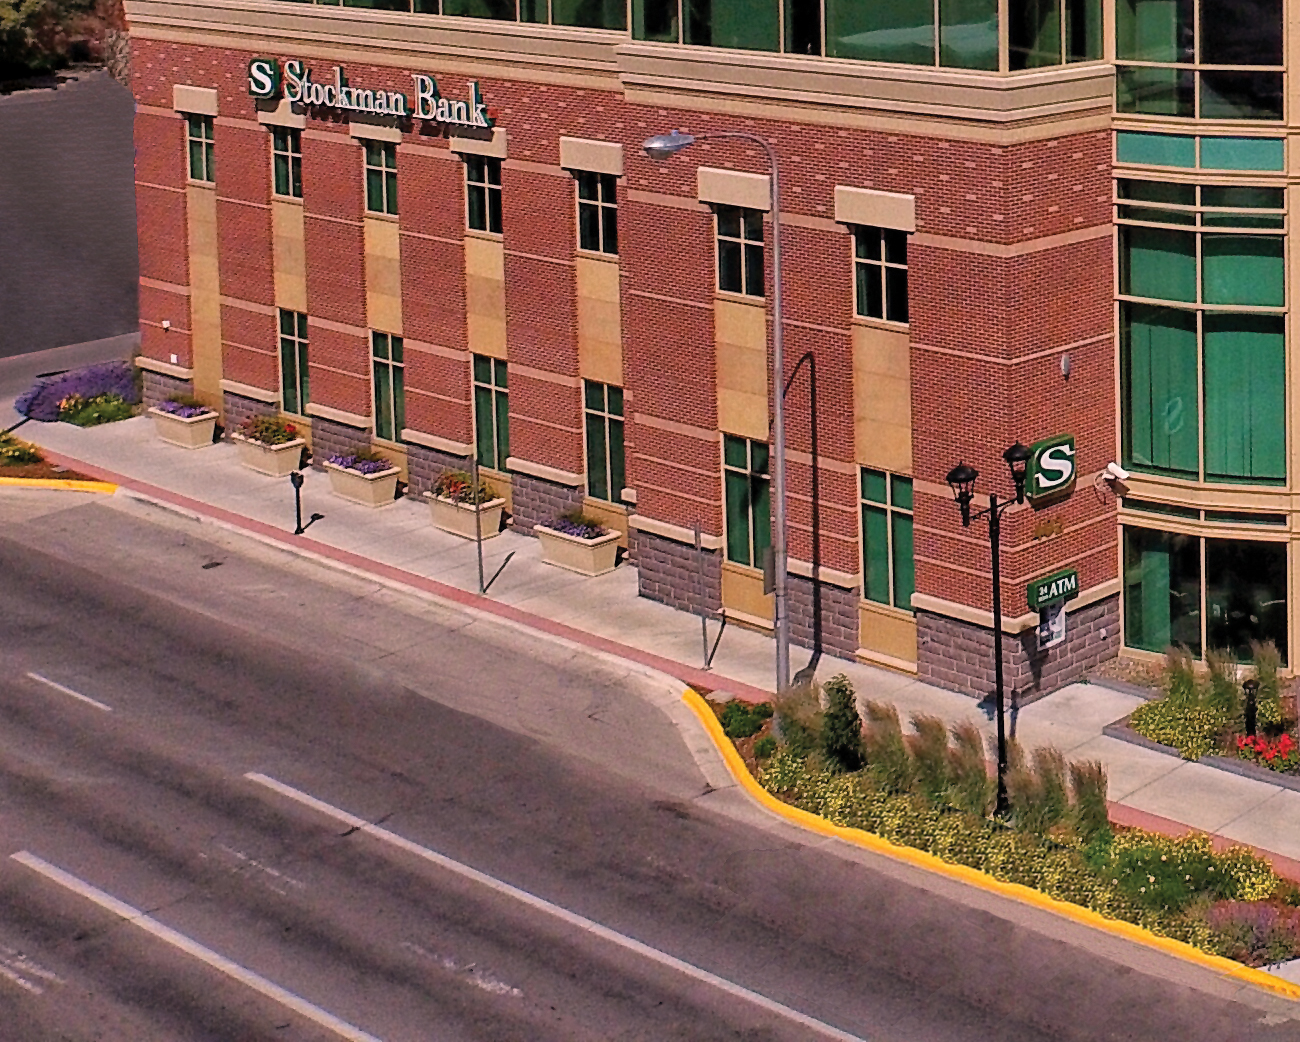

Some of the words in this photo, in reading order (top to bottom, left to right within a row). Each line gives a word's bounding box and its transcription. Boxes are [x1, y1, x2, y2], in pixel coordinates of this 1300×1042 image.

[249, 62, 273, 94] S
[283, 60, 407, 116] Stockman
[410, 74, 488, 128] Bank
[1034, 444, 1075, 488] S
[1049, 574, 1075, 598] ATM
